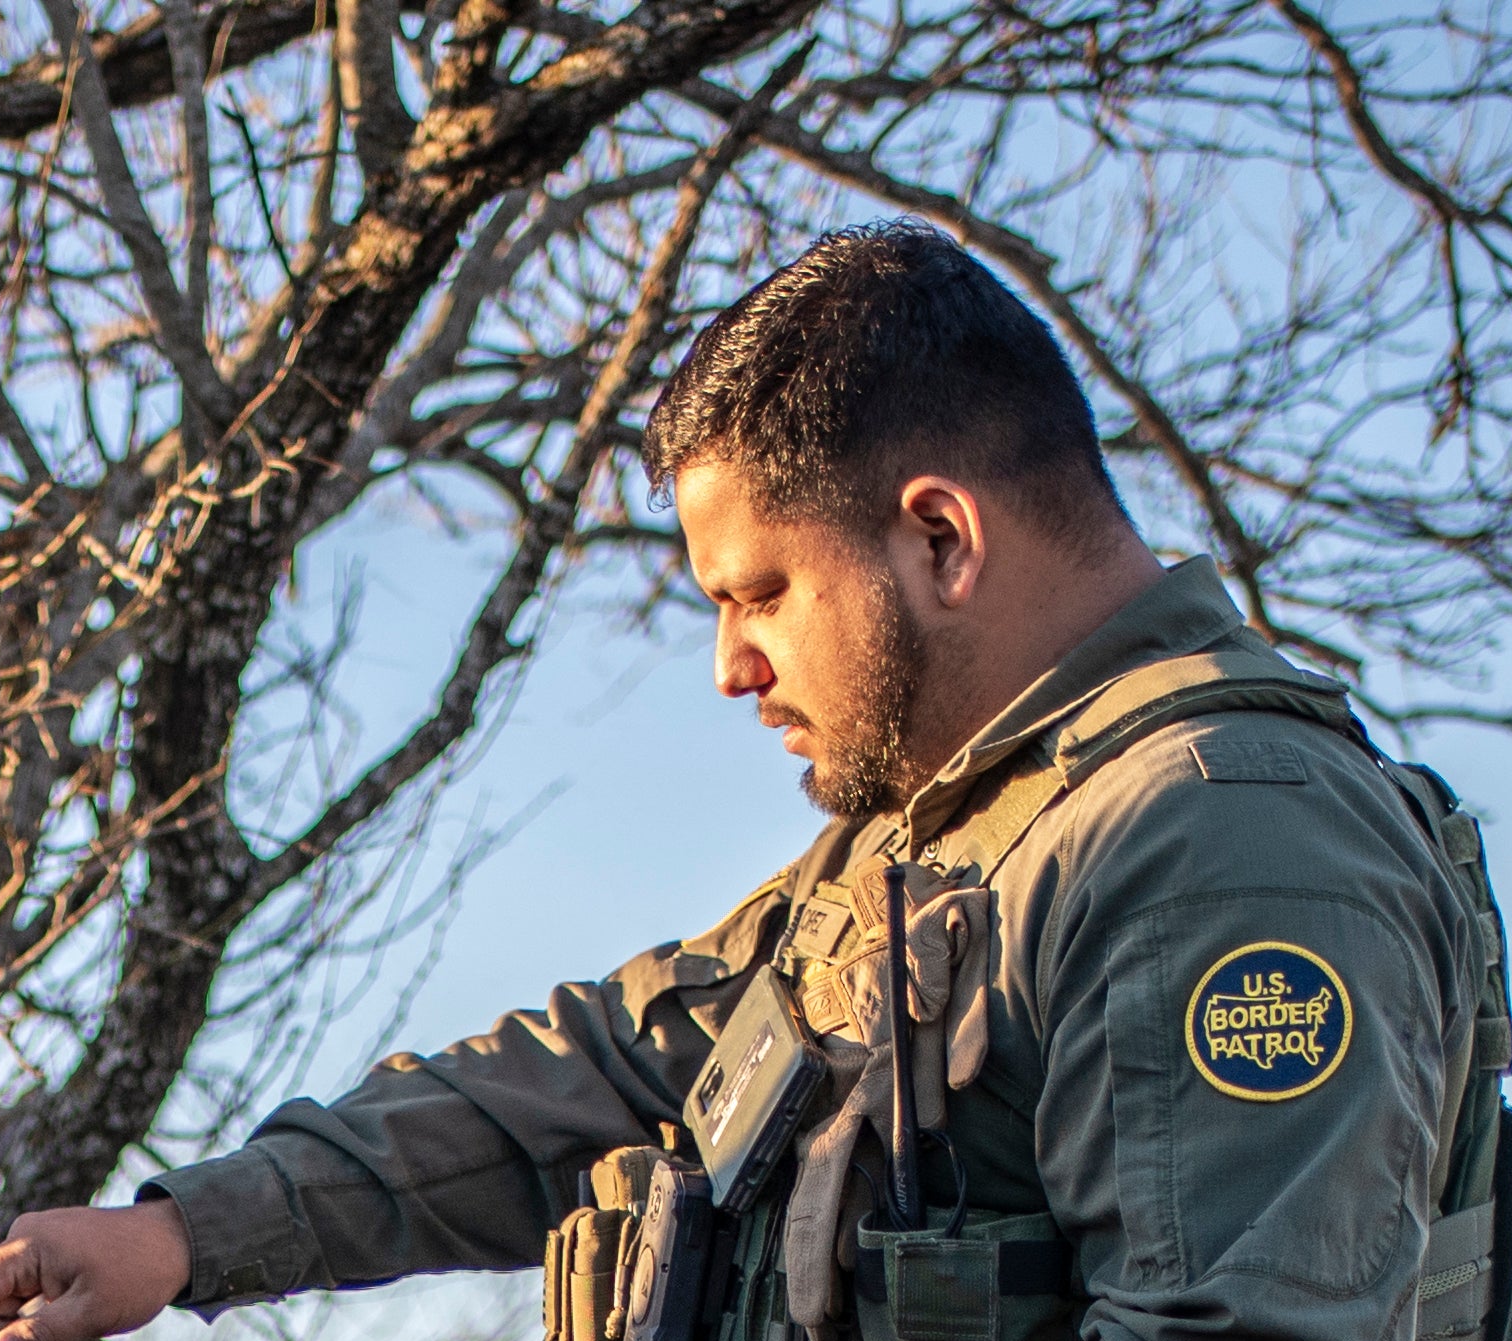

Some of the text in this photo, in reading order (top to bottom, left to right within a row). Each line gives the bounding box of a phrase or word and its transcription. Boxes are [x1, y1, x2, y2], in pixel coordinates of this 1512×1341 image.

[1243, 972, 1292, 997] U.S.
[1210, 1001, 1326, 1032] BORDER
[1210, 1030, 1324, 1061] PATROL
